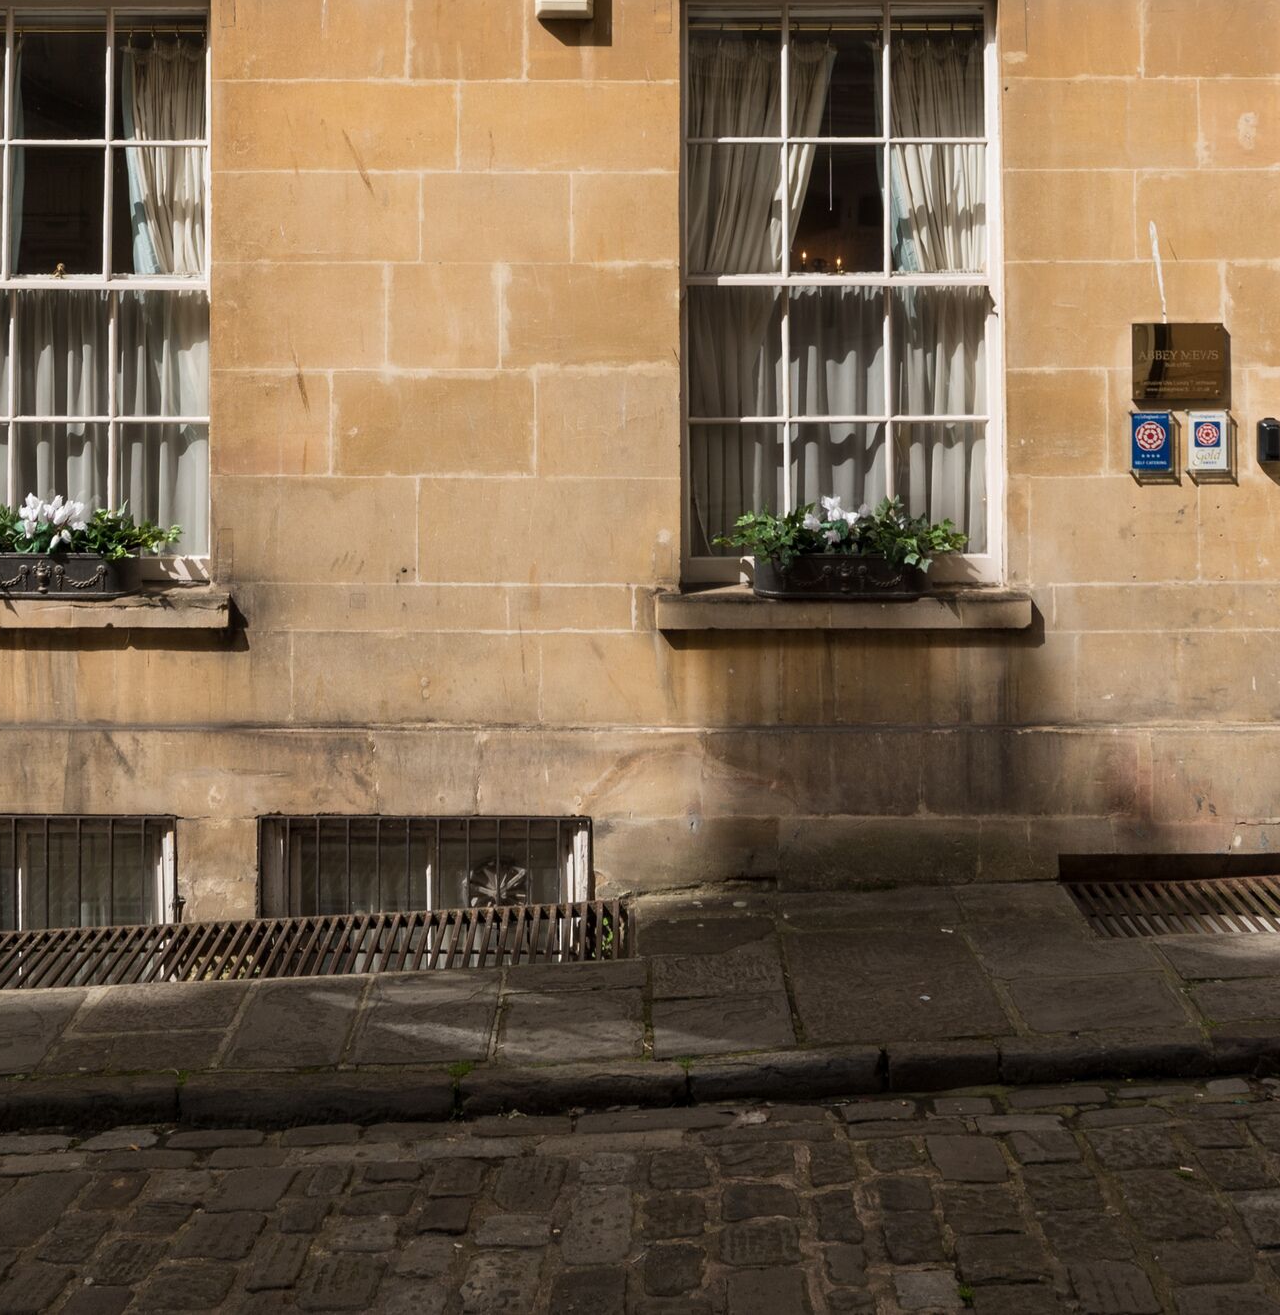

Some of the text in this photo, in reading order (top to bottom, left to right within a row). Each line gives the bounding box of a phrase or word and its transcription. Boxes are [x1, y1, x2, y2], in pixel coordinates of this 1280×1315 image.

[1138, 350, 1219, 360] ABBEY MEWS
[1192, 449, 1222, 466] Gold
